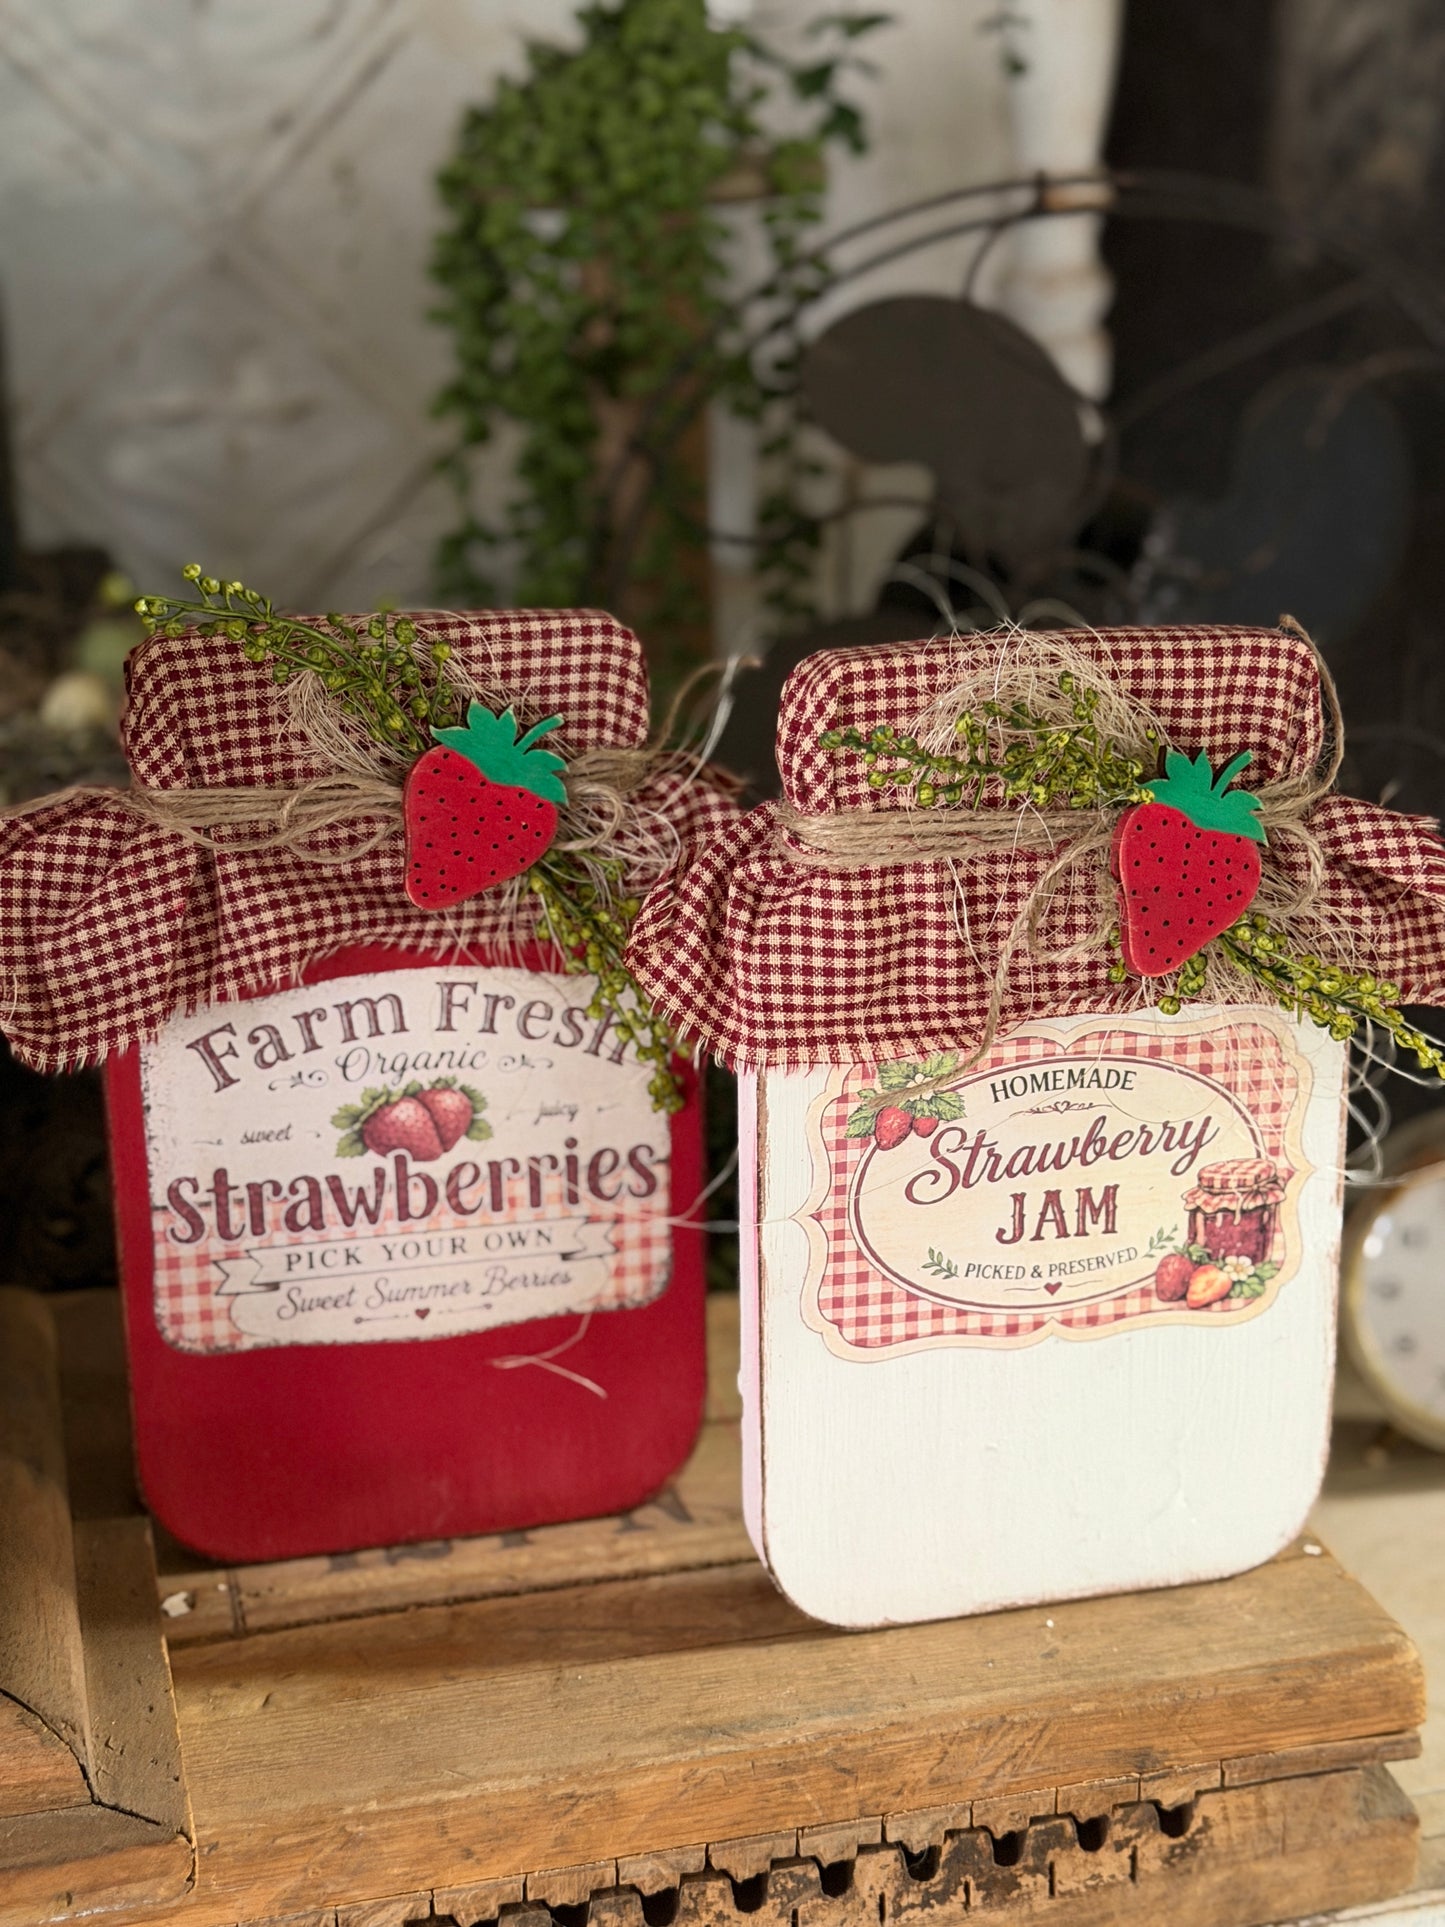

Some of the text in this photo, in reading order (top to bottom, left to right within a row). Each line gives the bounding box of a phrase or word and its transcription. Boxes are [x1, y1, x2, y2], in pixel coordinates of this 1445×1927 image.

[186, 980, 632, 1094] Farm Fresh
[335, 1043, 487, 1086] Organic
[990, 1068, 1138, 1104] HOMEMADE
[241, 1124, 293, 1145] sweet
[904, 1114, 1221, 1206] Strawberry
[995, 1183, 1121, 1245] JAM
[286, 1228, 554, 1273] PICK YOUR OWN
[964, 1246, 1139, 1281] PICKED & PRESERVED
[276, 1266, 573, 1321] Sweet Summer Berries
